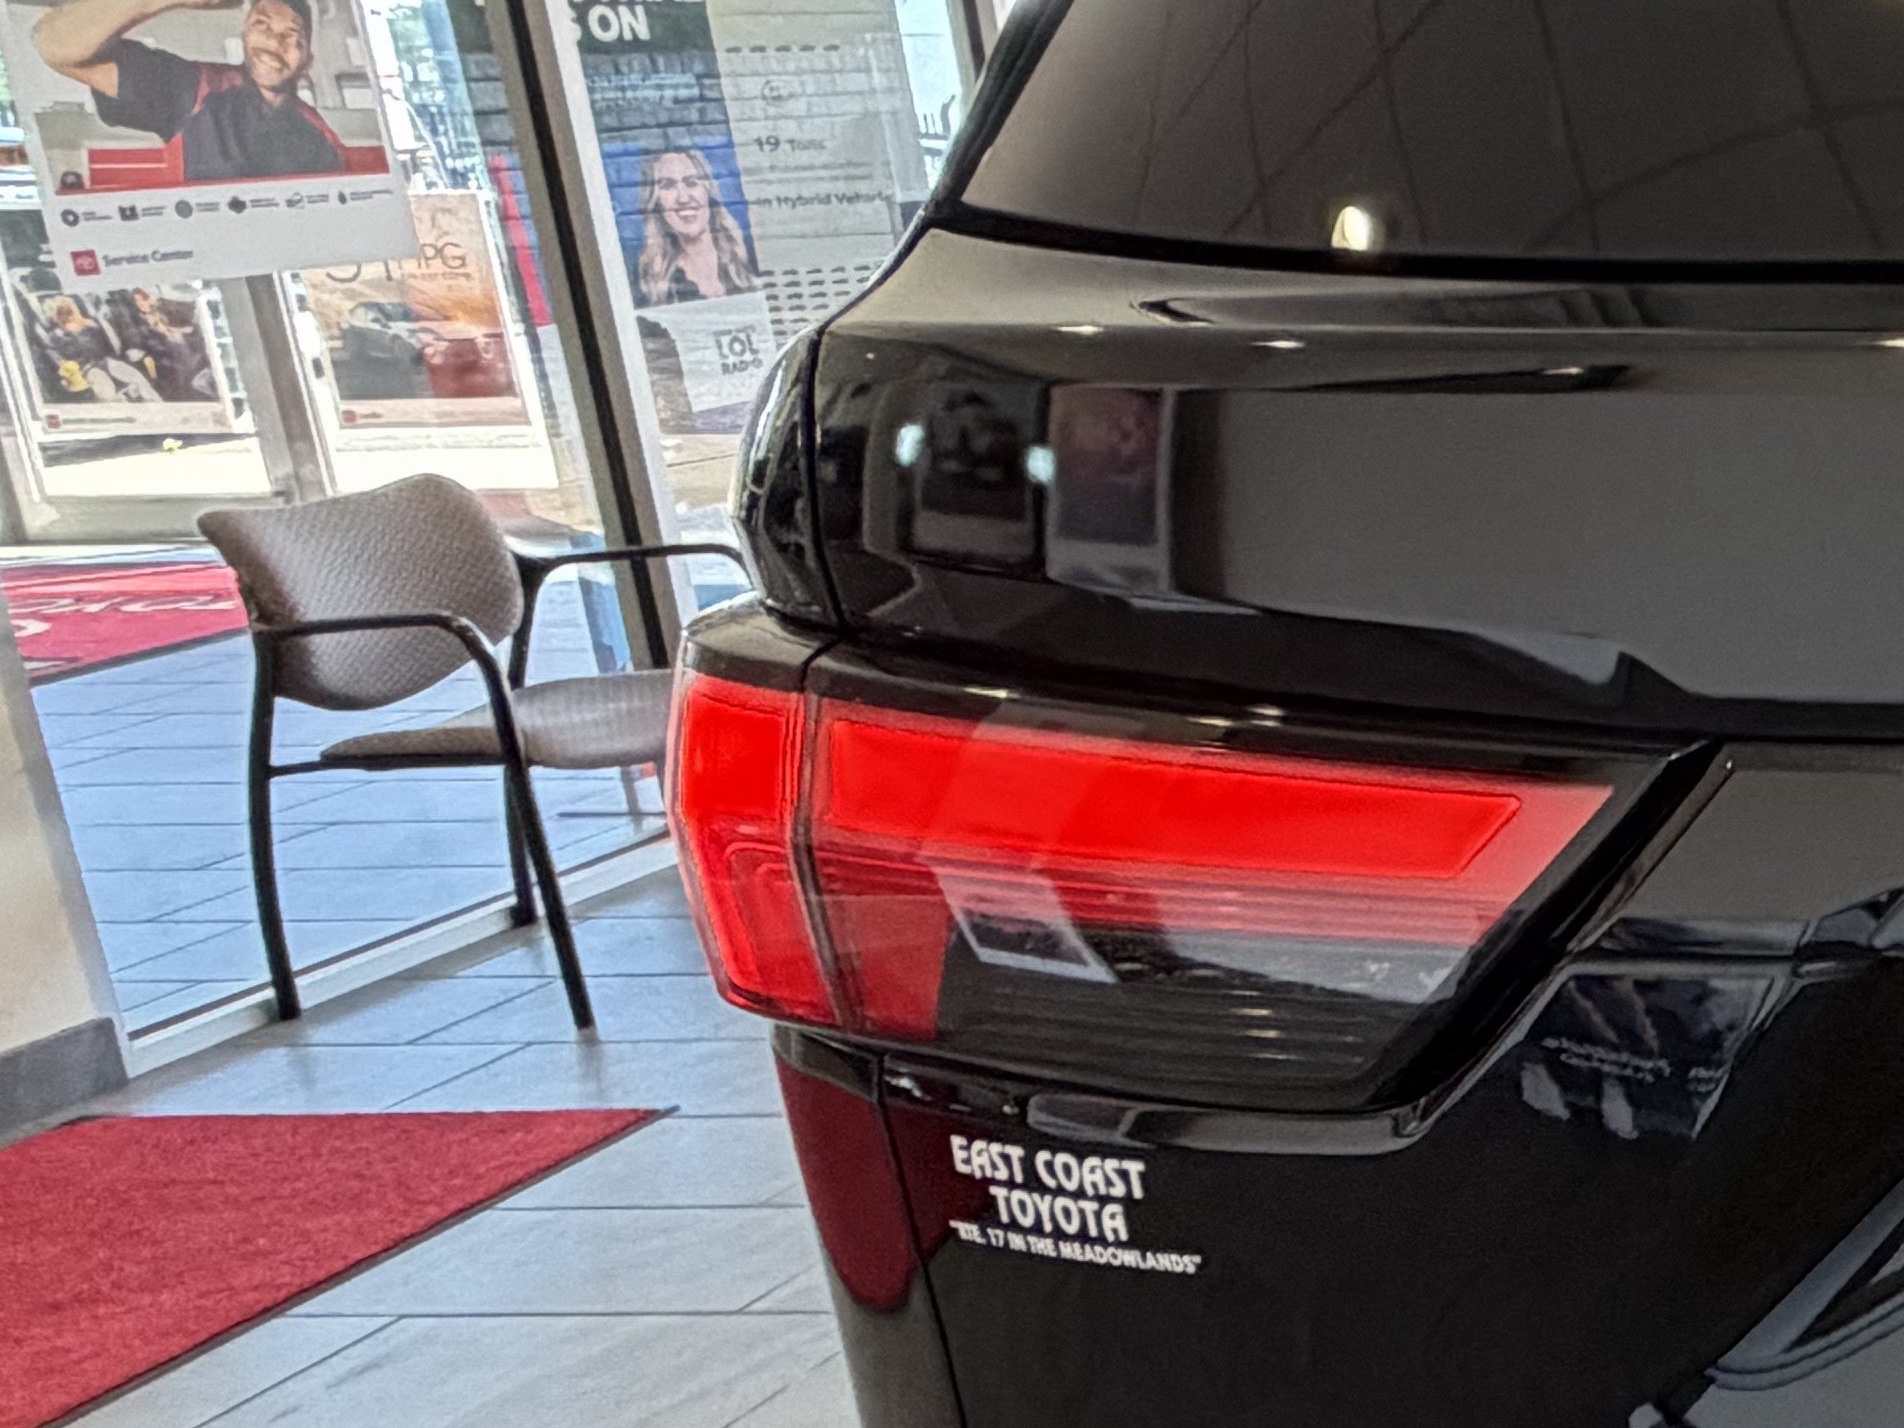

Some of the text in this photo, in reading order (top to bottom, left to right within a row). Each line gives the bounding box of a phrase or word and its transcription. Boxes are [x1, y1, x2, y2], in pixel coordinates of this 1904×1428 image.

[588, 4, 651, 43] ON
[754, 135, 781, 153] 19
[101, 253, 150, 268] Service
[418, 241, 467, 270] PG
[949, 1133, 1147, 1201] EAST COAST
[988, 1184, 1130, 1244] TOYOTA
[987, 1227, 1006, 1248] 17
[1008, 1230, 1026, 1251] IN
[1026, 1234, 1058, 1258] THE
